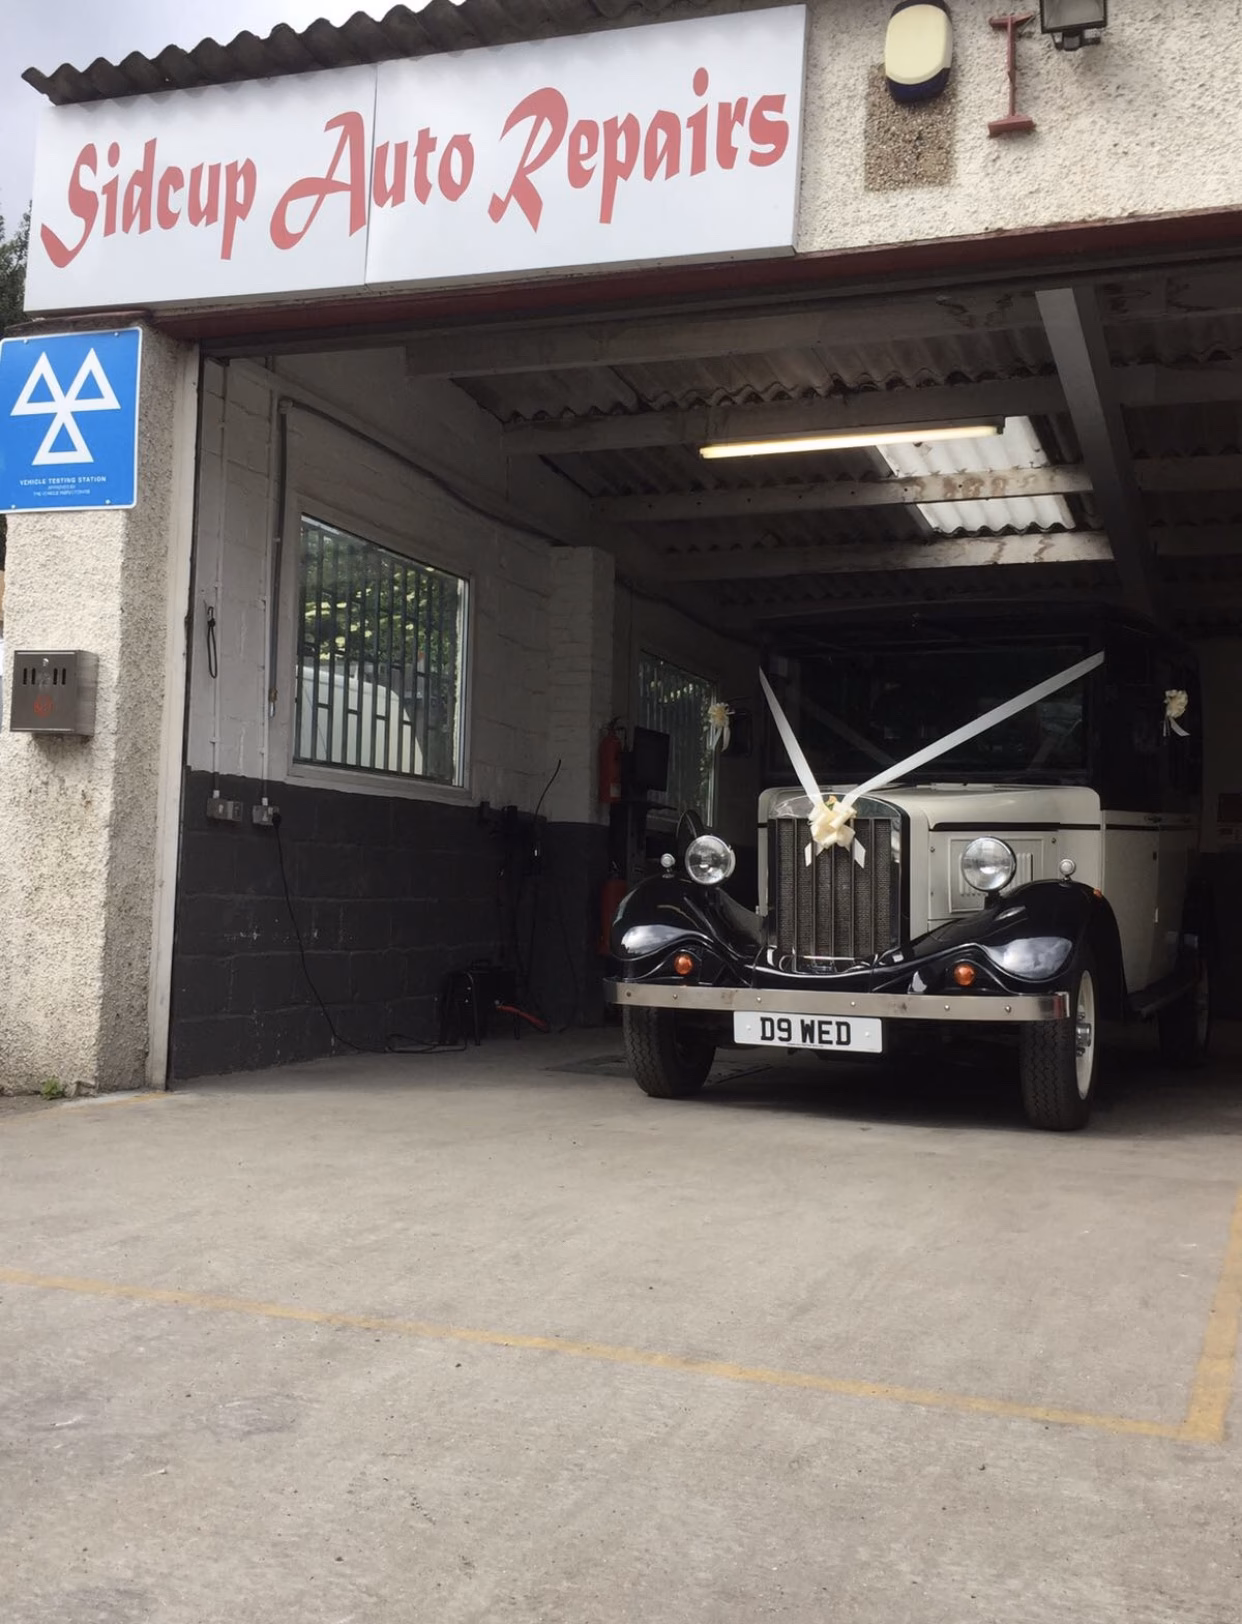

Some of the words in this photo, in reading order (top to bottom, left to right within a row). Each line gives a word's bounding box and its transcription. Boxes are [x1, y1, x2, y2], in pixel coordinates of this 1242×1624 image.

[40, 137, 257, 268] Sidcup
[269, 111, 475, 250] Auto
[488, 66, 790, 233] Repairs
[19, 478, 46, 486] VEHICLE
[48, 476, 76, 484] TESTING
[78, 475, 107, 483] STATION
[760, 1016, 792, 1042] D9
[800, 1018, 851, 1046] WED
